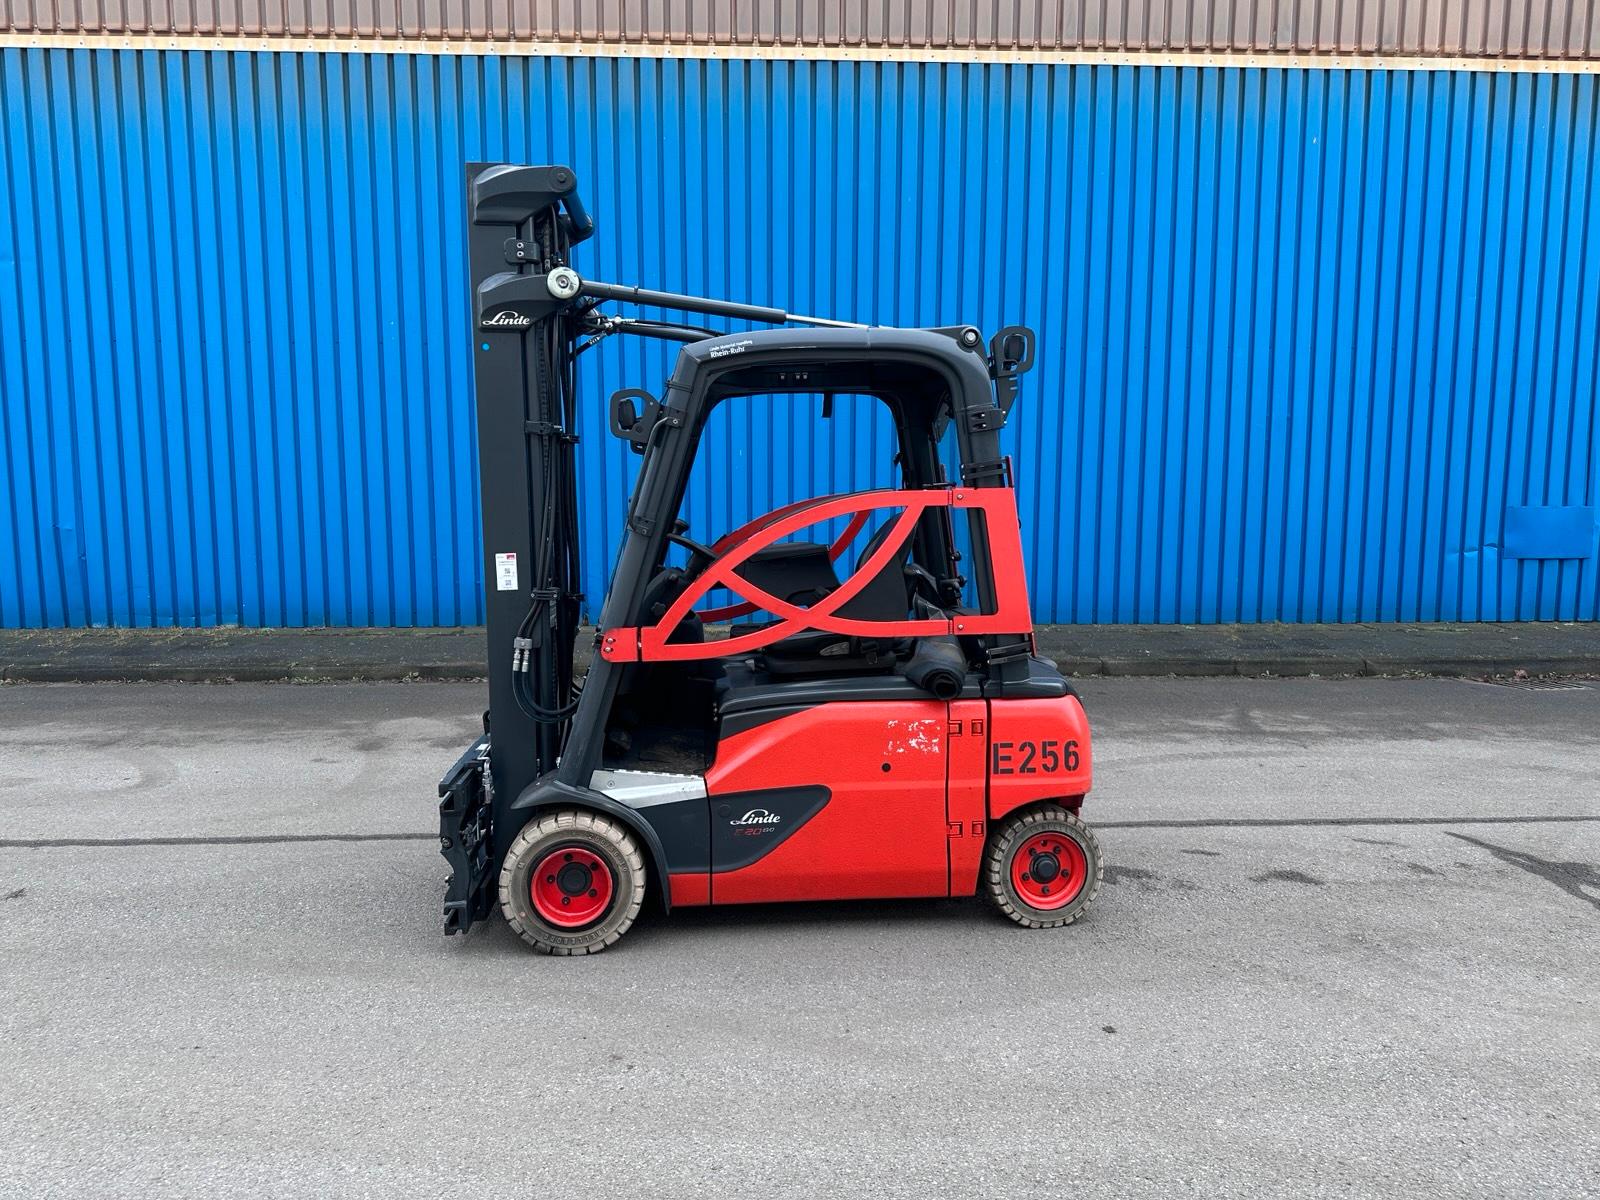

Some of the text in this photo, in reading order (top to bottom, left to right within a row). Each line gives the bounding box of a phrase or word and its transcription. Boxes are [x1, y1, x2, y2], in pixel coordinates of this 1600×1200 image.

[482, 310, 530, 326] Linde
[710, 346, 745, 358] Rhein-Ruhr
[992, 740, 1080, 775] E256
[730, 809, 781, 825] Linde
